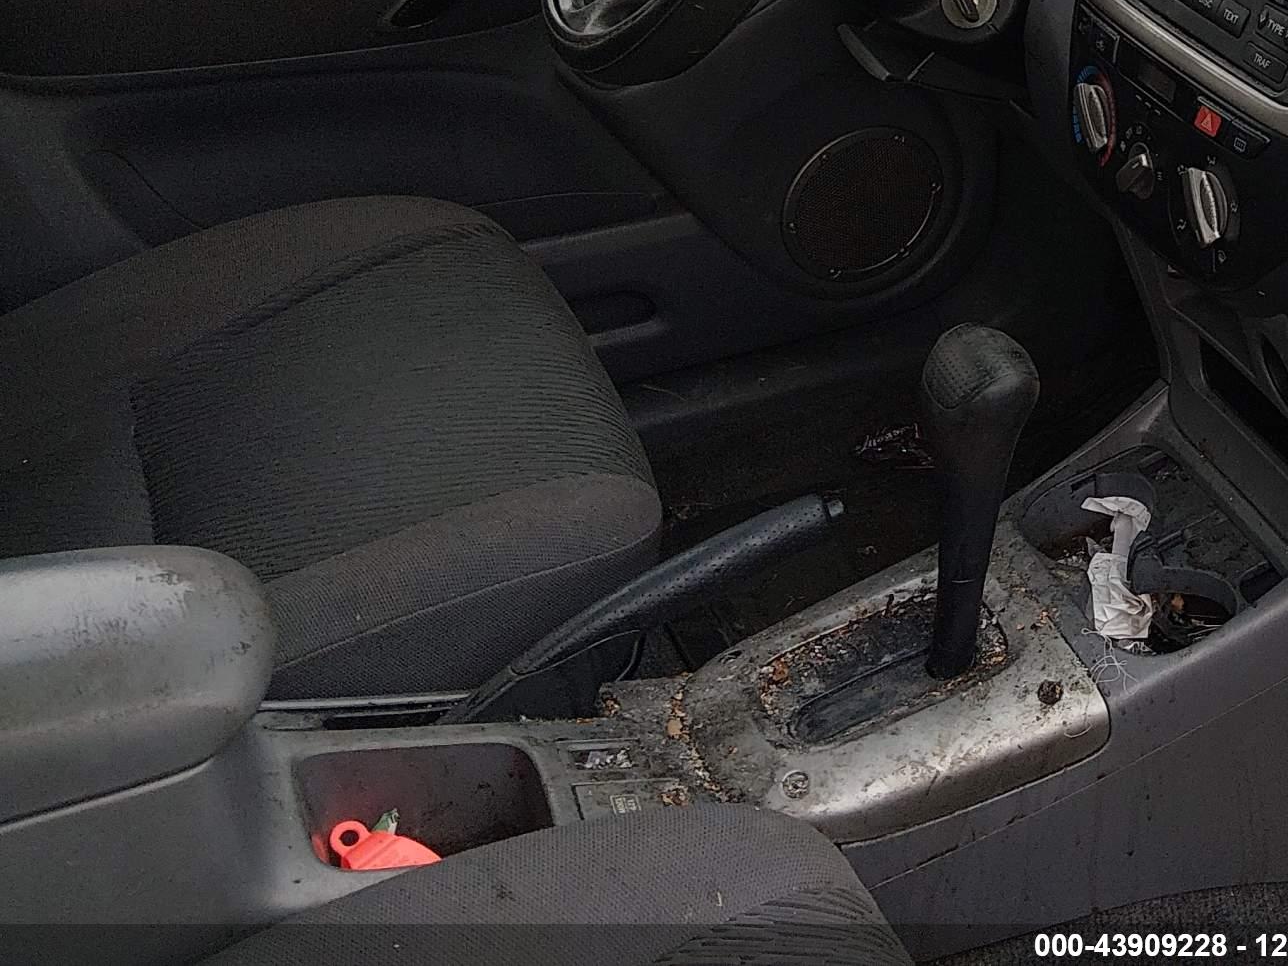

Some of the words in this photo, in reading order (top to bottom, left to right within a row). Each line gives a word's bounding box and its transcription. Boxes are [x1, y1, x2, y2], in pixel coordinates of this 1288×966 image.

[1223, 8, 1239, 24] TEXT
[1267, 18, 1286, 36] TYPE
[1253, 53, 1272, 69] TRAF
